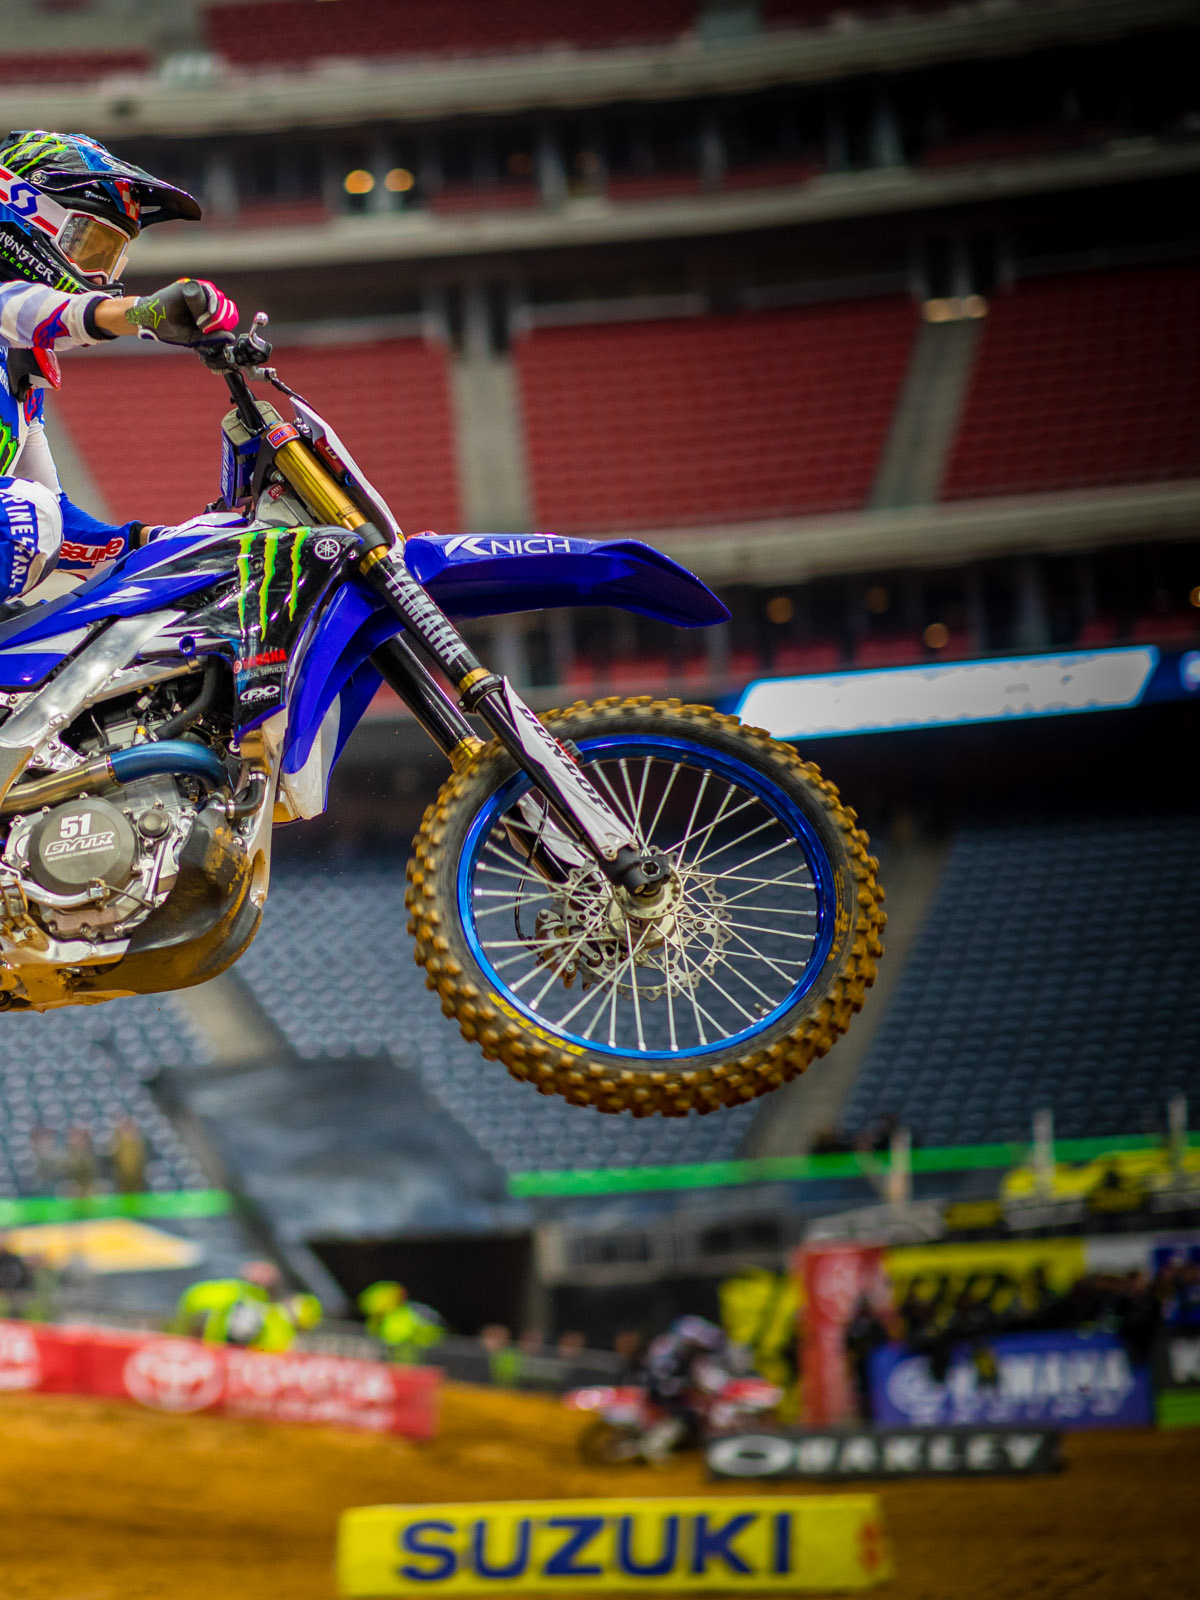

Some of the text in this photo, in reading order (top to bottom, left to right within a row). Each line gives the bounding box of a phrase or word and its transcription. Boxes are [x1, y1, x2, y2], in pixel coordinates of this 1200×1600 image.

[385, 567, 467, 666] YAMAHA
[516, 705, 612, 814] DUNLOP
[60, 813, 91, 838] 51
[399, 1511, 792, 1582] SUZUKI
